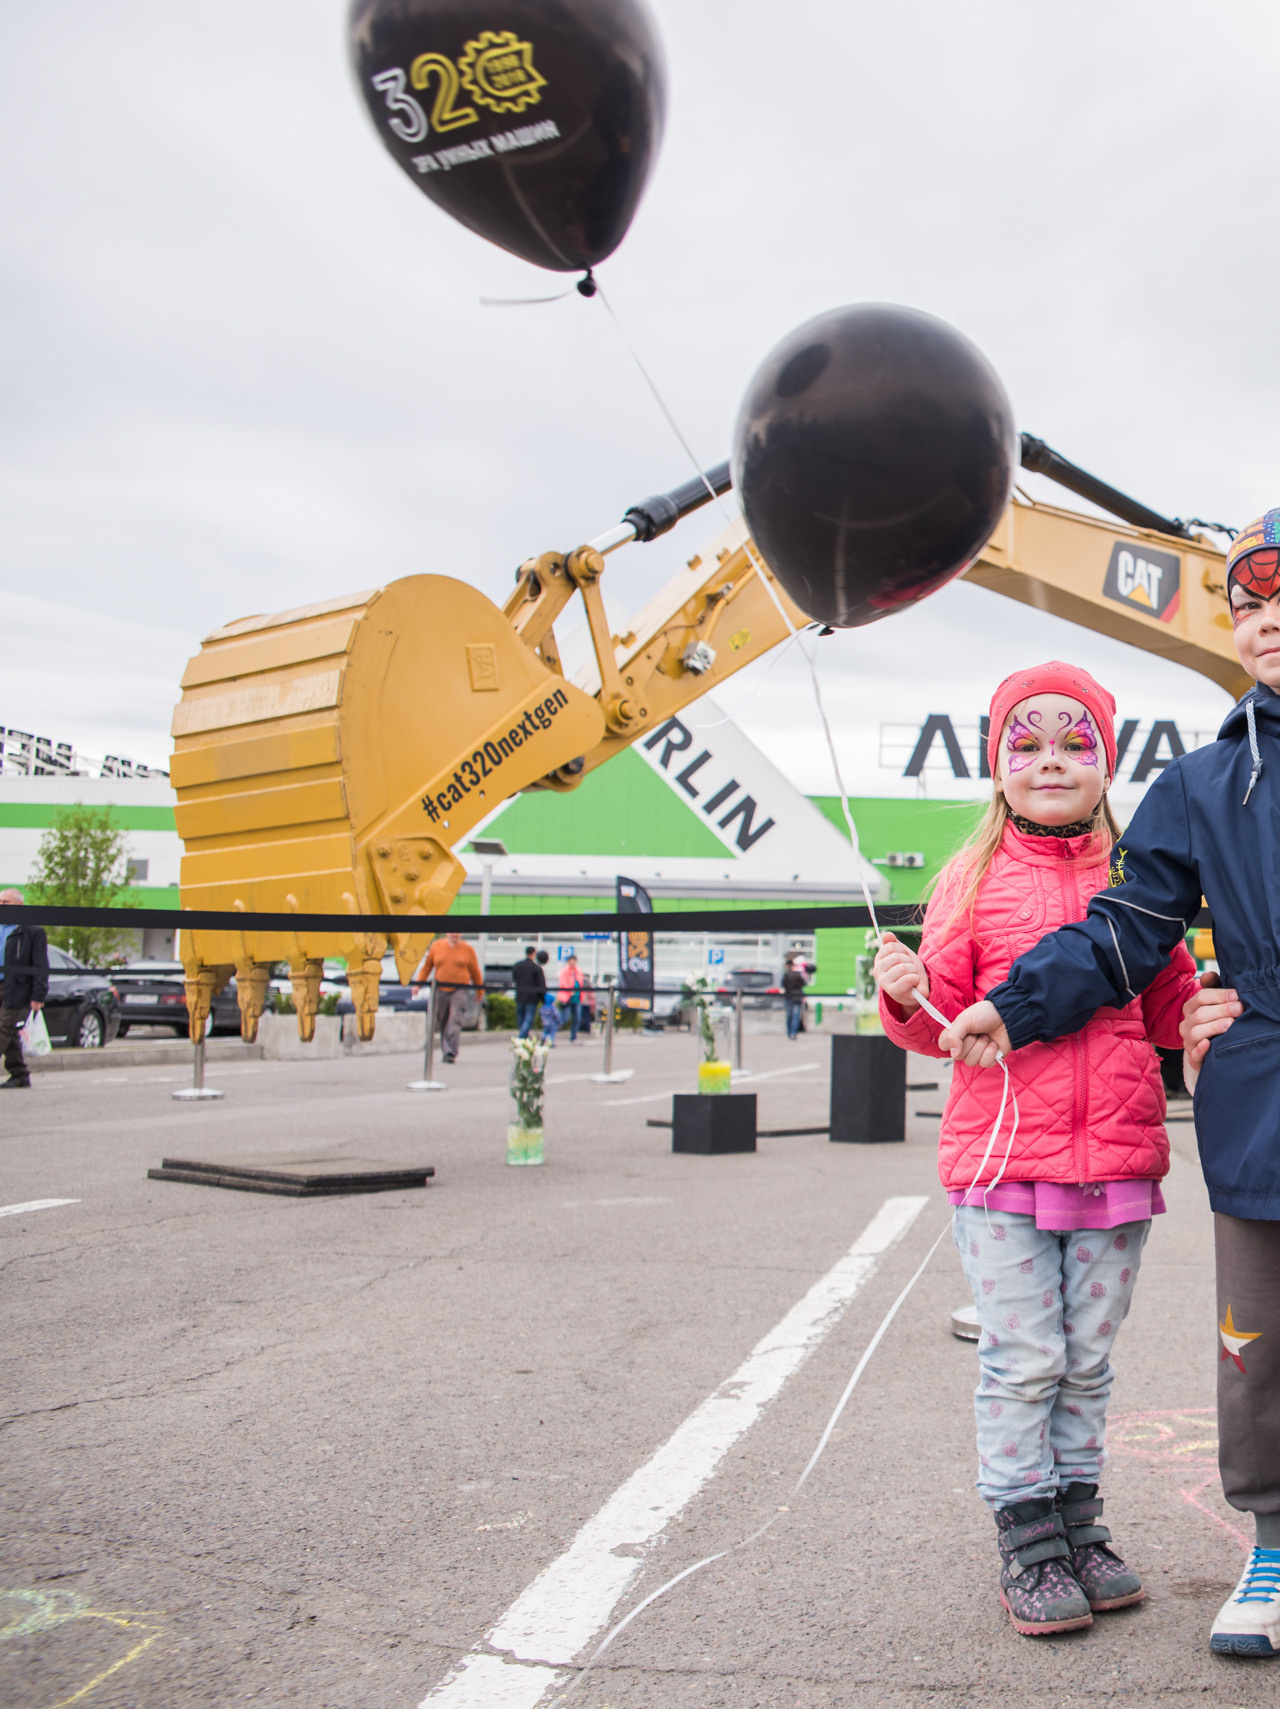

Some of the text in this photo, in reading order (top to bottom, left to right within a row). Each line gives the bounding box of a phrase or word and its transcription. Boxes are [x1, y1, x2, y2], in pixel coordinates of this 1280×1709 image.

[1117, 550, 1163, 610] CAT
[421, 688, 569, 823] #cat320nextgen
[643, 715, 776, 852] RLIN
